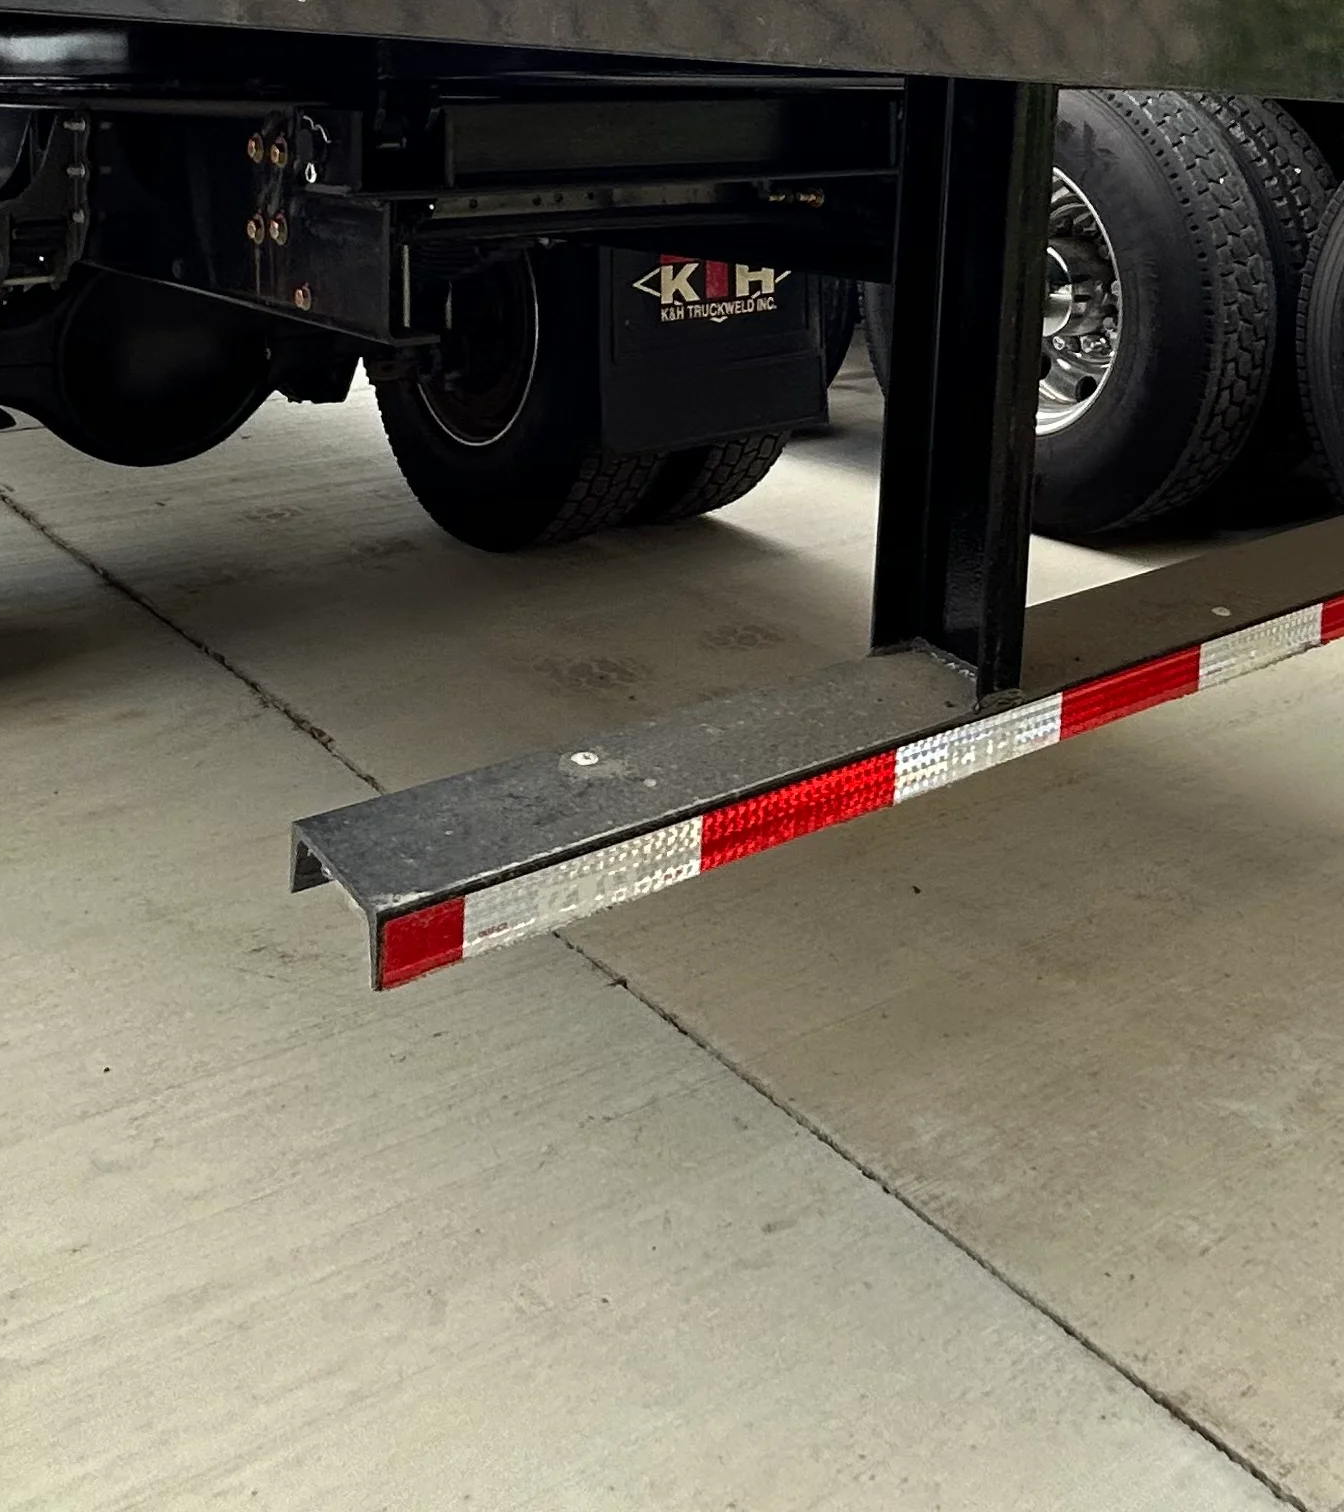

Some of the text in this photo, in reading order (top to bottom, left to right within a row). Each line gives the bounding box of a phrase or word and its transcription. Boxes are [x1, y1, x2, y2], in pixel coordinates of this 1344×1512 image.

[661, 296, 777, 322] K&H TRUCKWELD INC.
